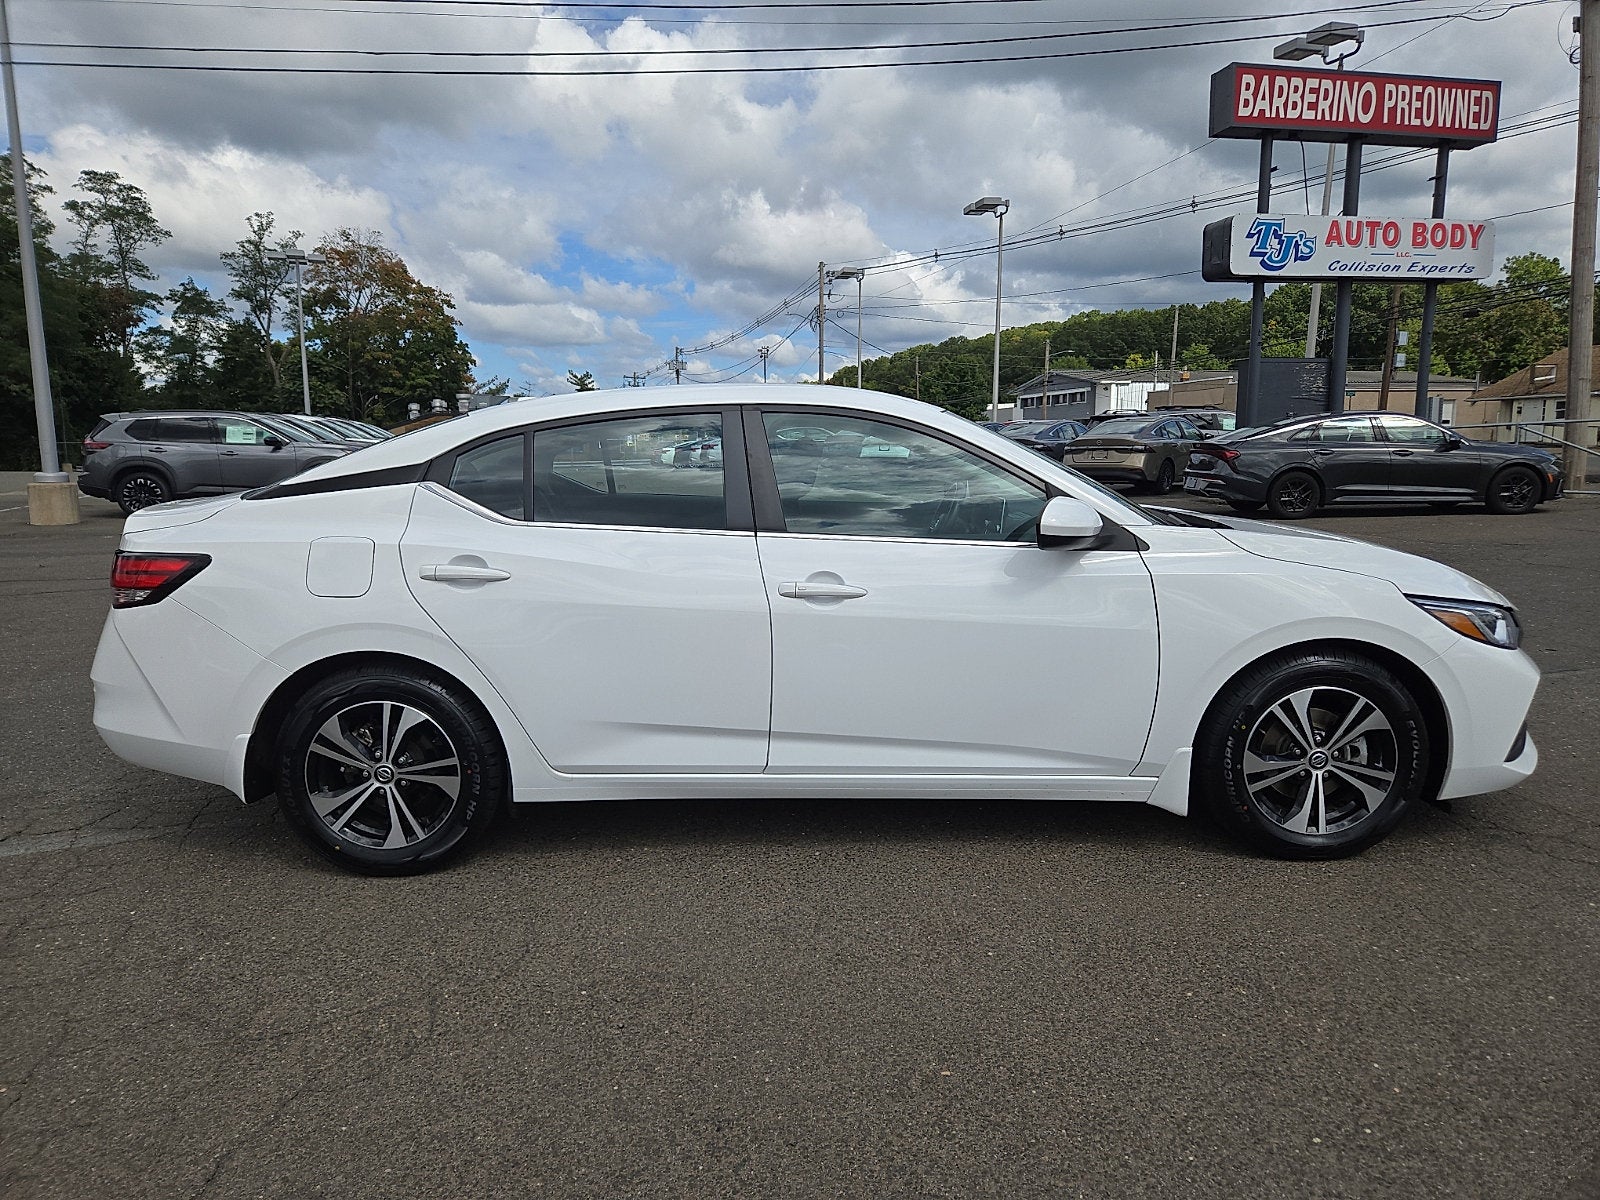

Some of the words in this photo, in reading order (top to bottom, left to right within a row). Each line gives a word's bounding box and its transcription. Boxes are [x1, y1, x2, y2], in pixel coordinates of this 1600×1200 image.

[1237, 74, 1377, 124] BARBERINO
[1383, 84, 1494, 131] PREOWNED
[1324, 220, 1401, 249] AUTO
[1411, 222, 1485, 250] BODY
[1327, 260, 1401, 274] Collision
[1406, 261, 1475, 275] Experts
[465, 799, 477, 821] HP
